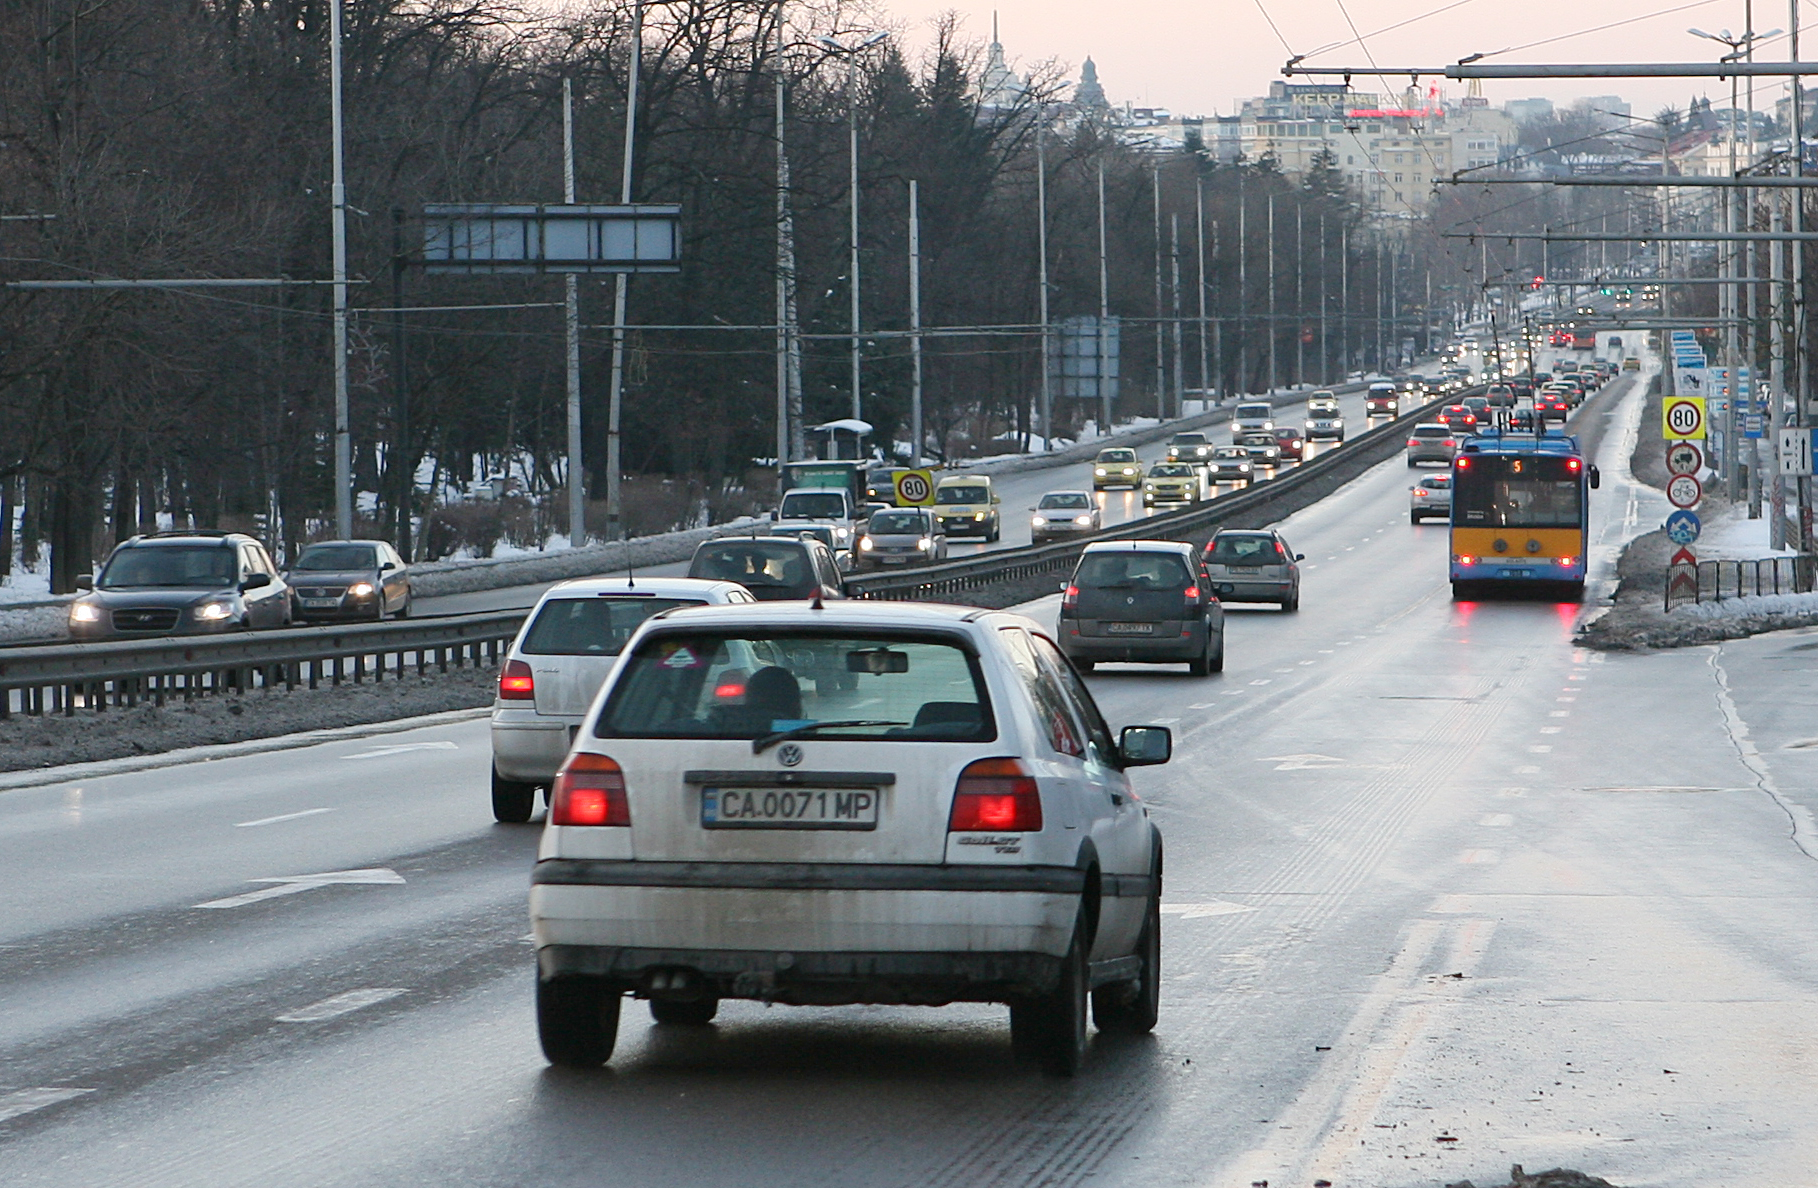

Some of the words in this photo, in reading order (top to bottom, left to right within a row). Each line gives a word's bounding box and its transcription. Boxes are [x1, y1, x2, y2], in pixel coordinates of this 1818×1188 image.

[1292, 93, 1340, 106] KEEP
[1673, 409, 1694, 427] 80
[1513, 460, 1523, 473] 5
[904, 480, 924, 496] 80
